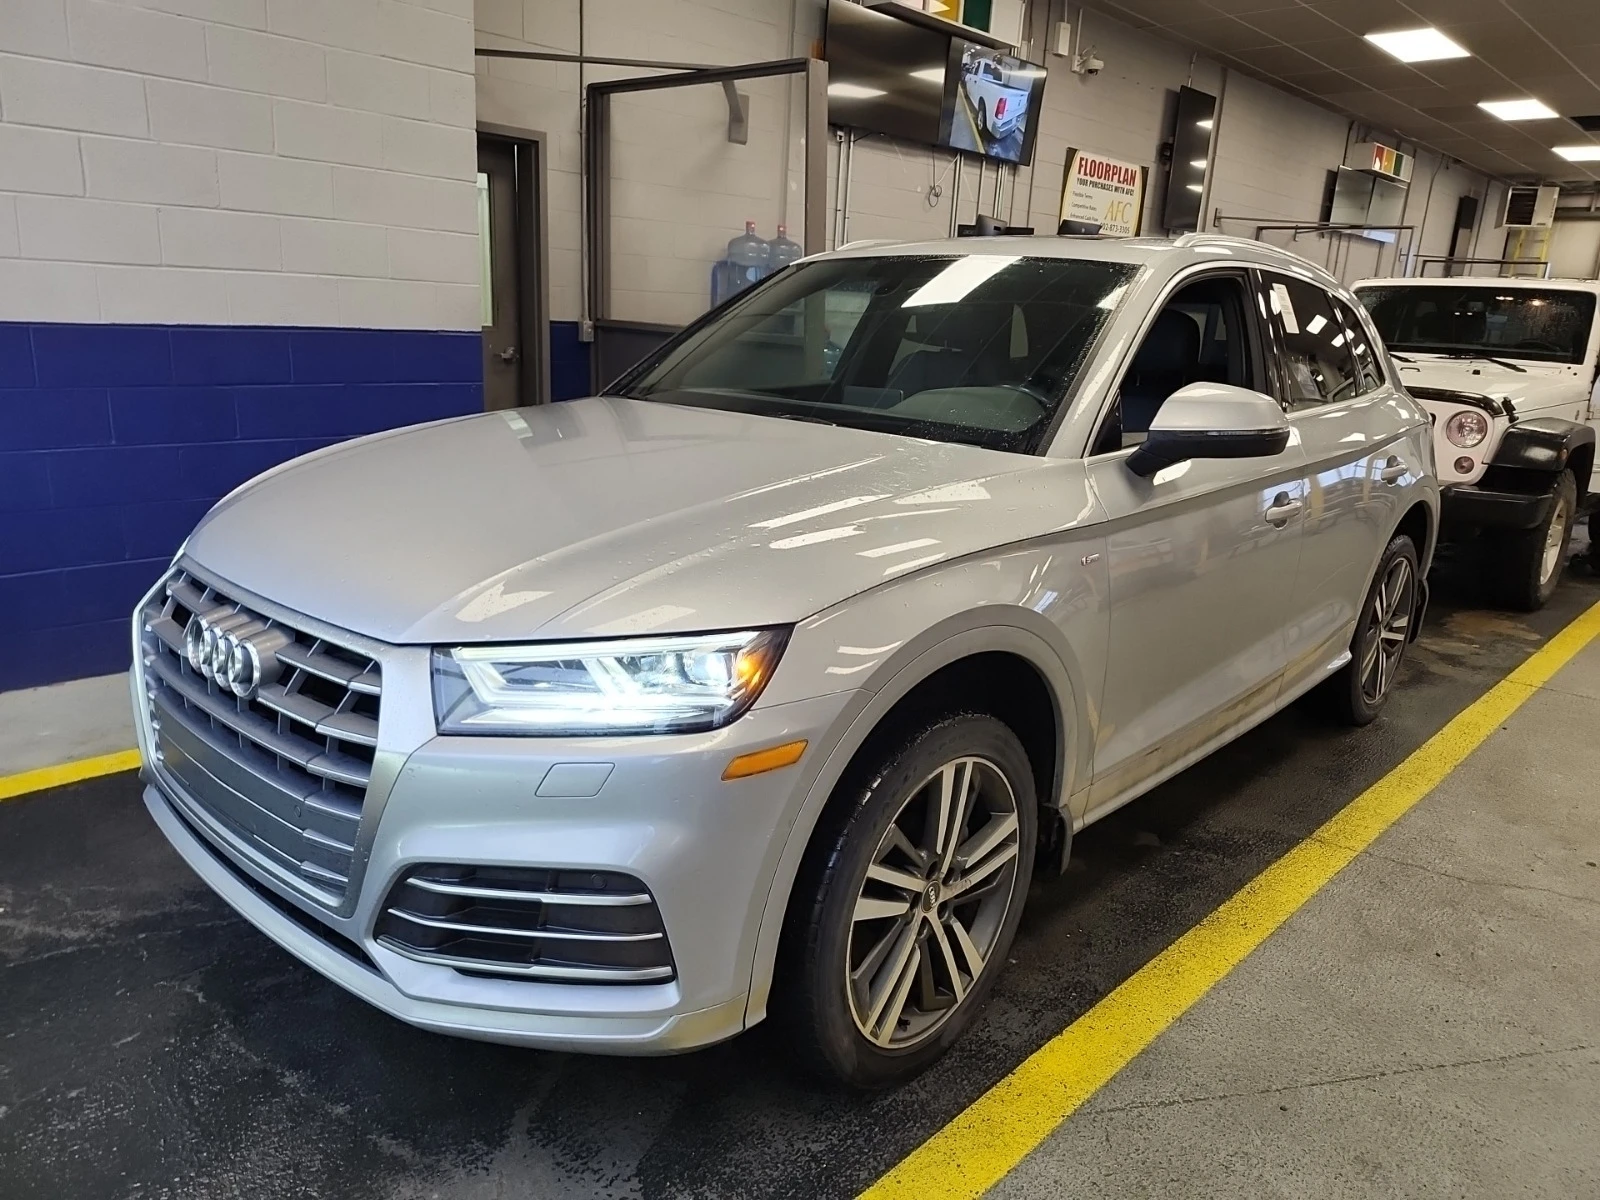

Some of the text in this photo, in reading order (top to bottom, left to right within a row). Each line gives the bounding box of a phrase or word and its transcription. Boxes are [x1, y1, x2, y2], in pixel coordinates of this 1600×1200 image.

[1077, 156, 1137, 187] FLOORPLAN
[1077, 177, 1088, 187] YOUR
[1088, 180, 1114, 192] PURCHASES
[1114, 185, 1125, 195] WITH
[1104, 199, 1132, 224] AFC
